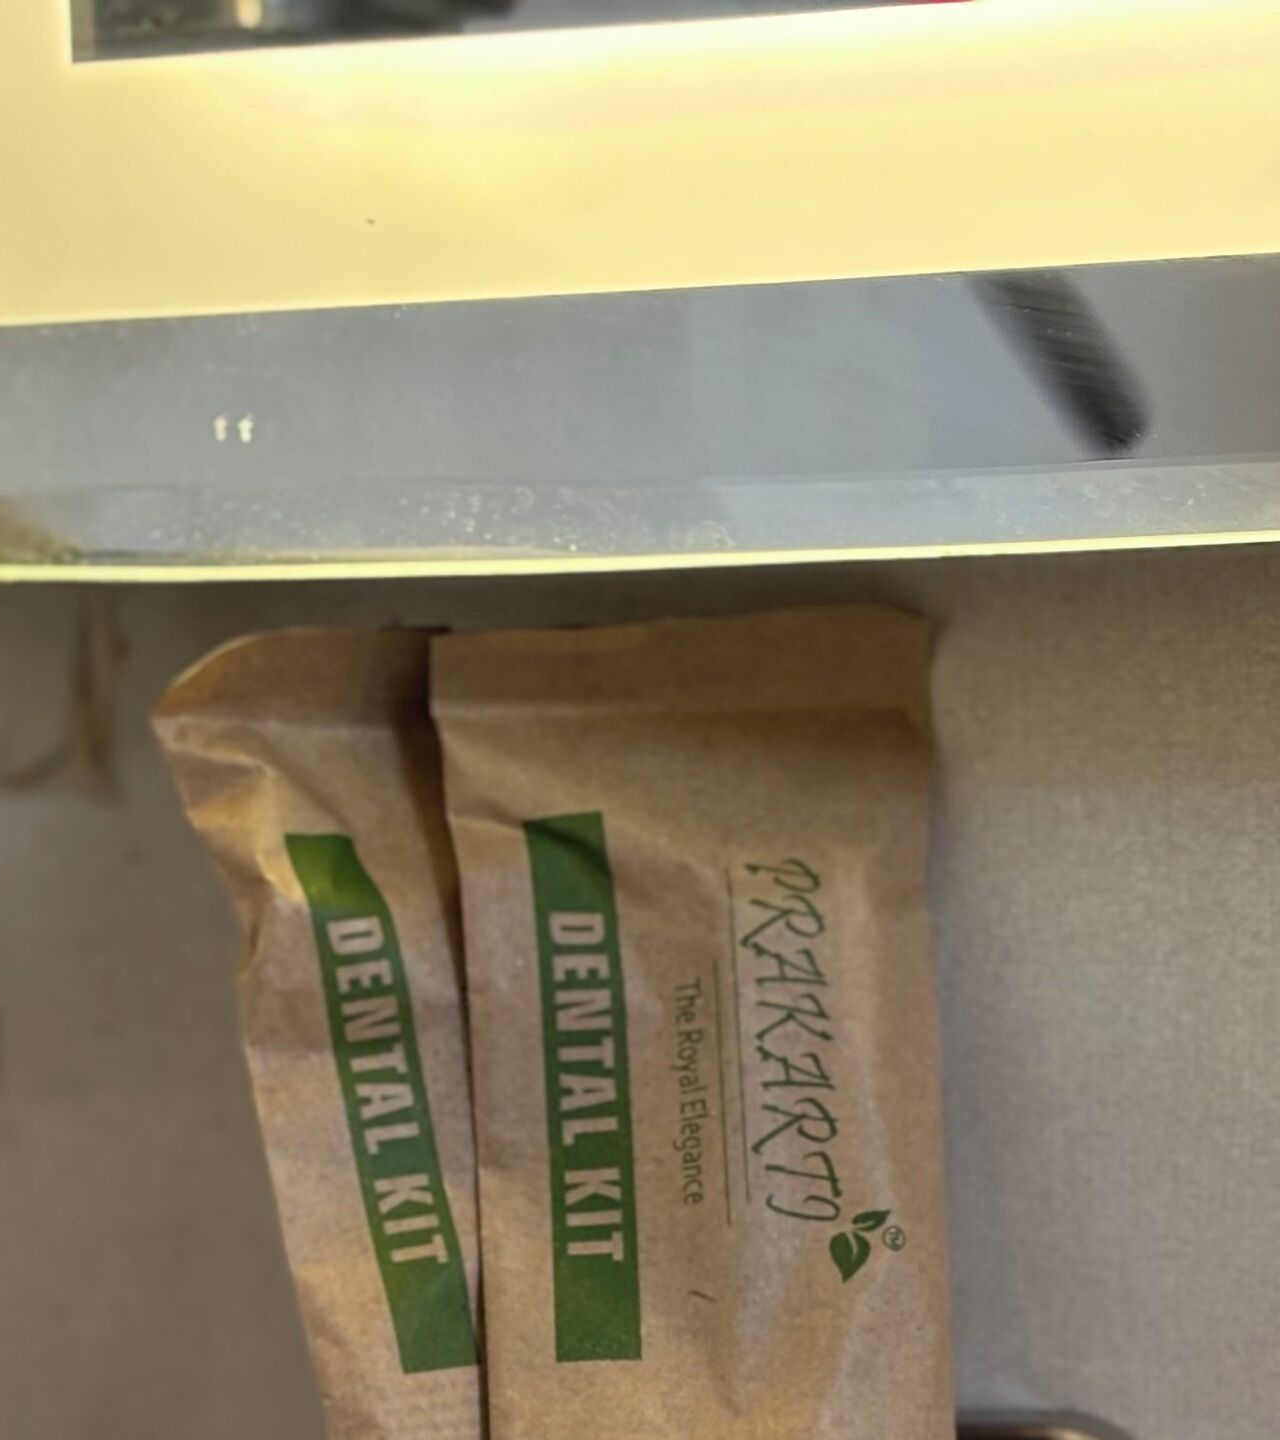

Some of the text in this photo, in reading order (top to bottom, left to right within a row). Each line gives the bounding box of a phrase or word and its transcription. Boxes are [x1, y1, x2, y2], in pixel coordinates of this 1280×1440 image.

[325, 915, 449, 1265] DENTAL KIT
[548, 911, 624, 1262] DENTAL KIT
[670, 977, 708, 1206] The Royal Elegance
